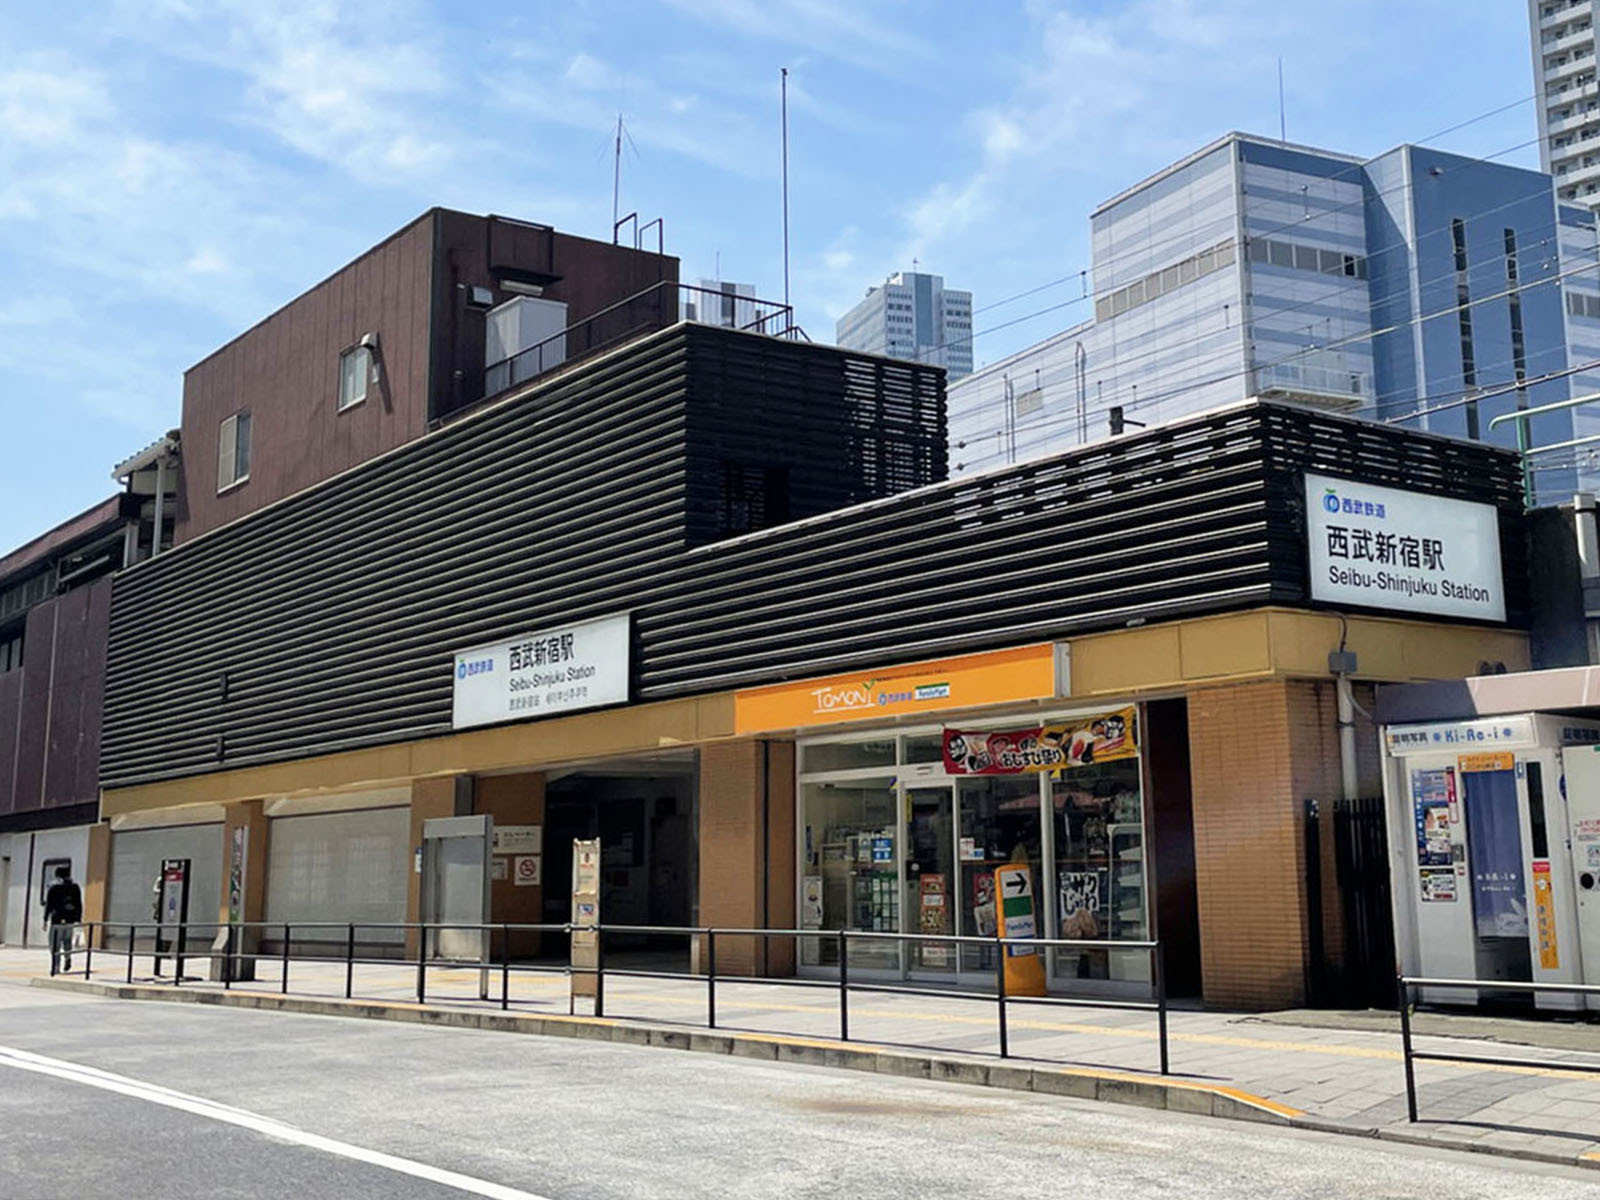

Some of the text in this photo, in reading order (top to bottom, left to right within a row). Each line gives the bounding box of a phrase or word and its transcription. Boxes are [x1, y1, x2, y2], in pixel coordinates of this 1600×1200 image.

[1342, 498, 1385, 518] 西武鉄道
[1326, 525, 1444, 571] 西武新宿駅
[1329, 566, 1489, 602] Seibu-Shinjuku Station
[468, 659, 494, 676] 西武鉄道
[509, 633, 575, 672] 西武新宿駅
[509, 665, 595, 692] Seibu-Shinjuku Station
